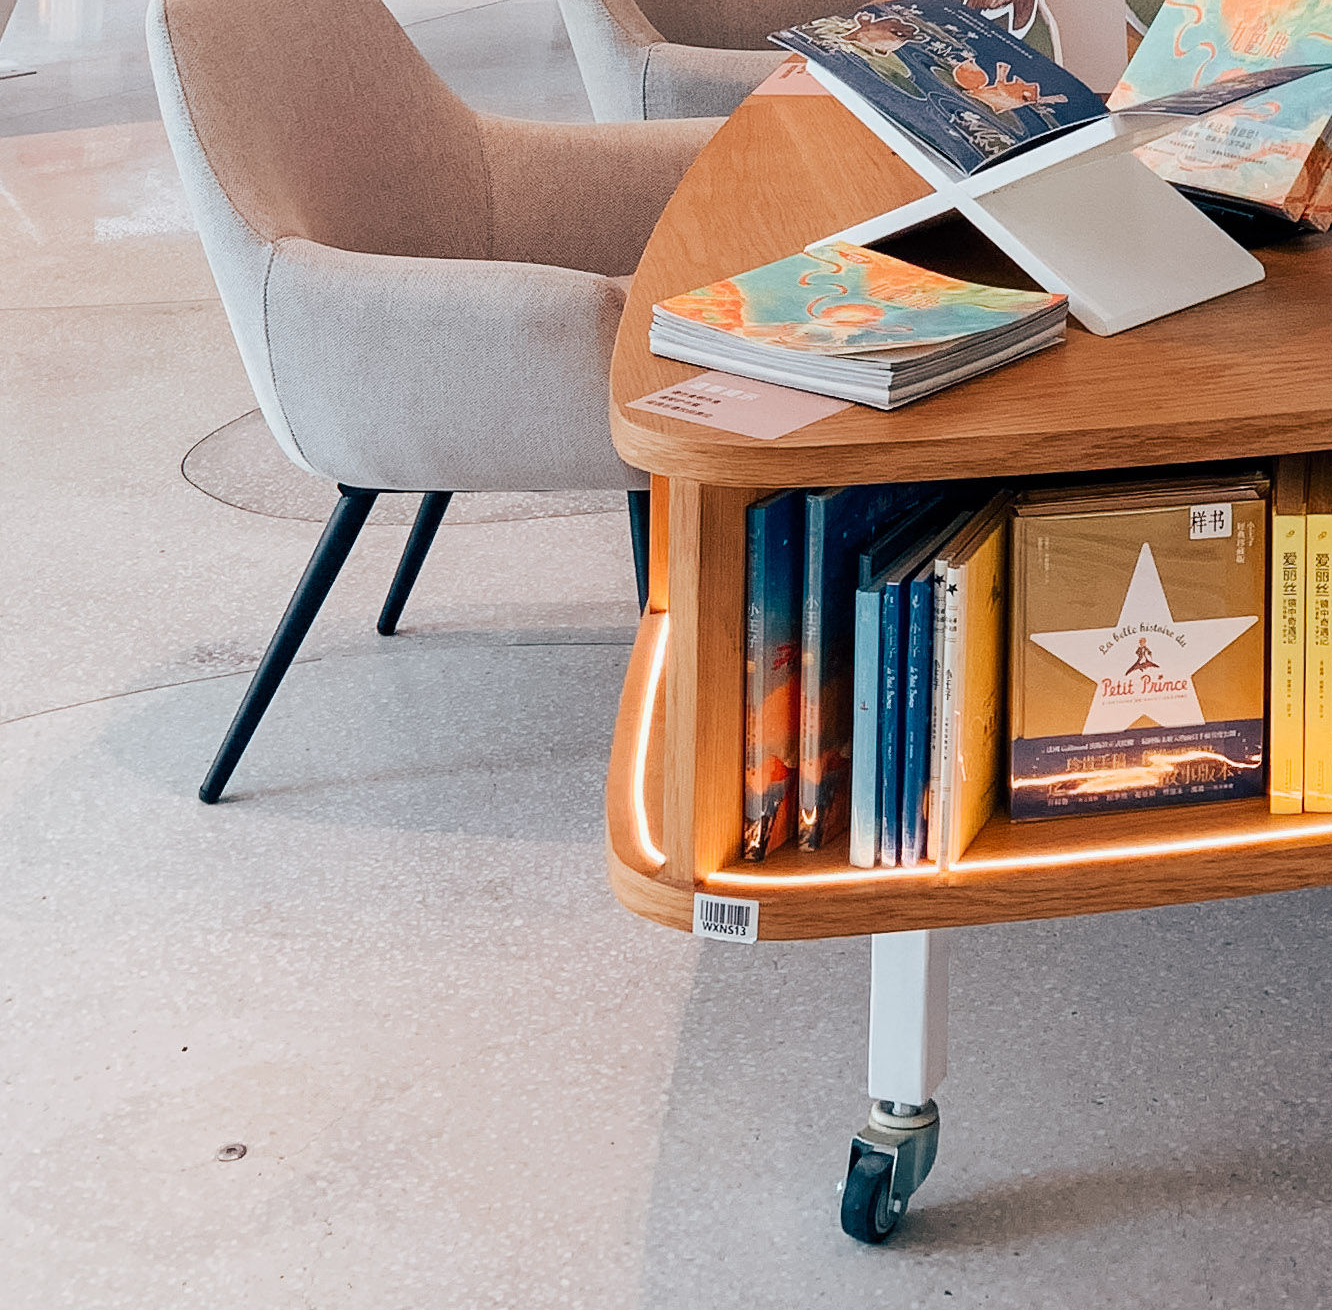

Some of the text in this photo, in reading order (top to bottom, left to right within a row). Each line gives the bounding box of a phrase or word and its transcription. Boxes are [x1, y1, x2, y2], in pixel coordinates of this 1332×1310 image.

[1192, 509, 1225, 534] 样书
[1283, 552, 1298, 596] 爱丽丝
[1315, 553, 1330, 597] 爱丽丝
[1099, 622, 1188, 656] La belle histoire du
[1101, 674, 1188, 698] Petit Prince
[702, 921, 747, 936] WXNS13
